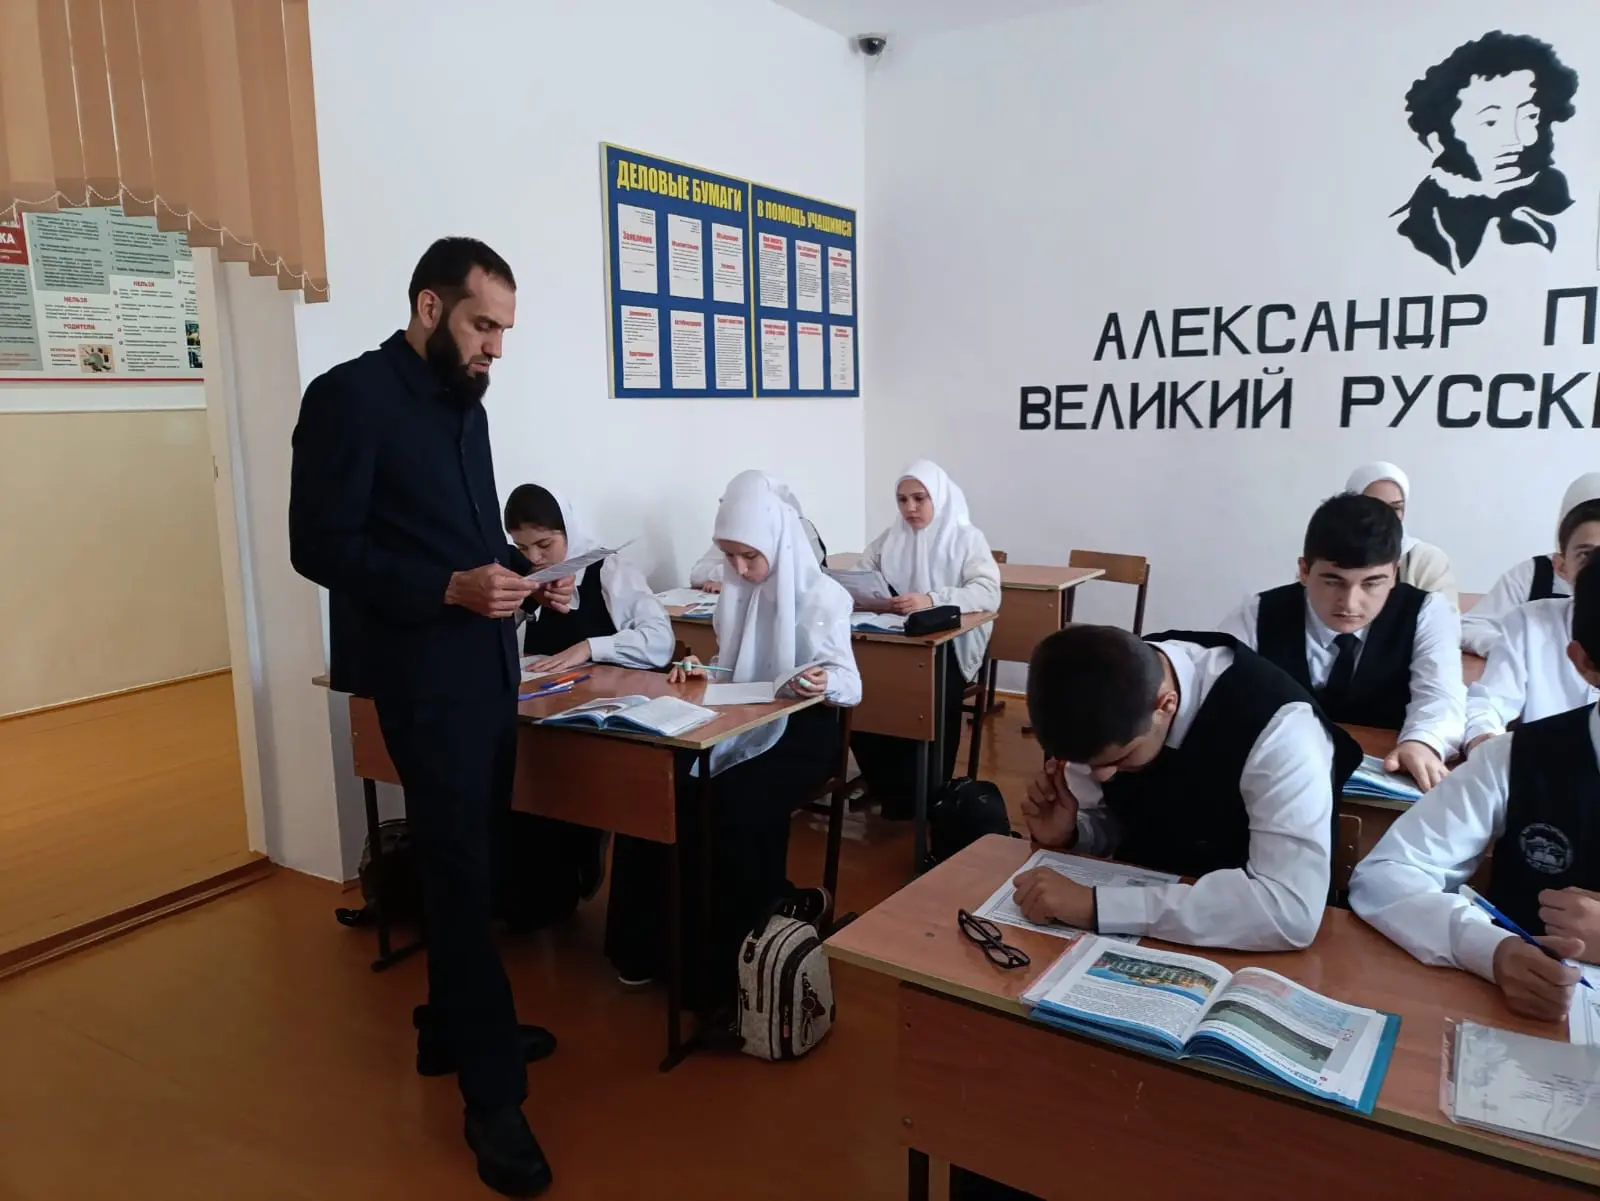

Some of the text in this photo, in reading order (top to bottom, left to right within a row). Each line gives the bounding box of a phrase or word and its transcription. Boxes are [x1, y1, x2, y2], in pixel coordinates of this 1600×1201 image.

[616, 159, 742, 213] ДЕЛОВЫЕ БУМАГИ
[757, 199, 764, 218] В
[766, 200, 806, 228] ПОМОЩЬ
[1093, 294, 1488, 361] АЛЕКСАНДР
[1019, 366, 1293, 430] ВЕЛИКИЙ
